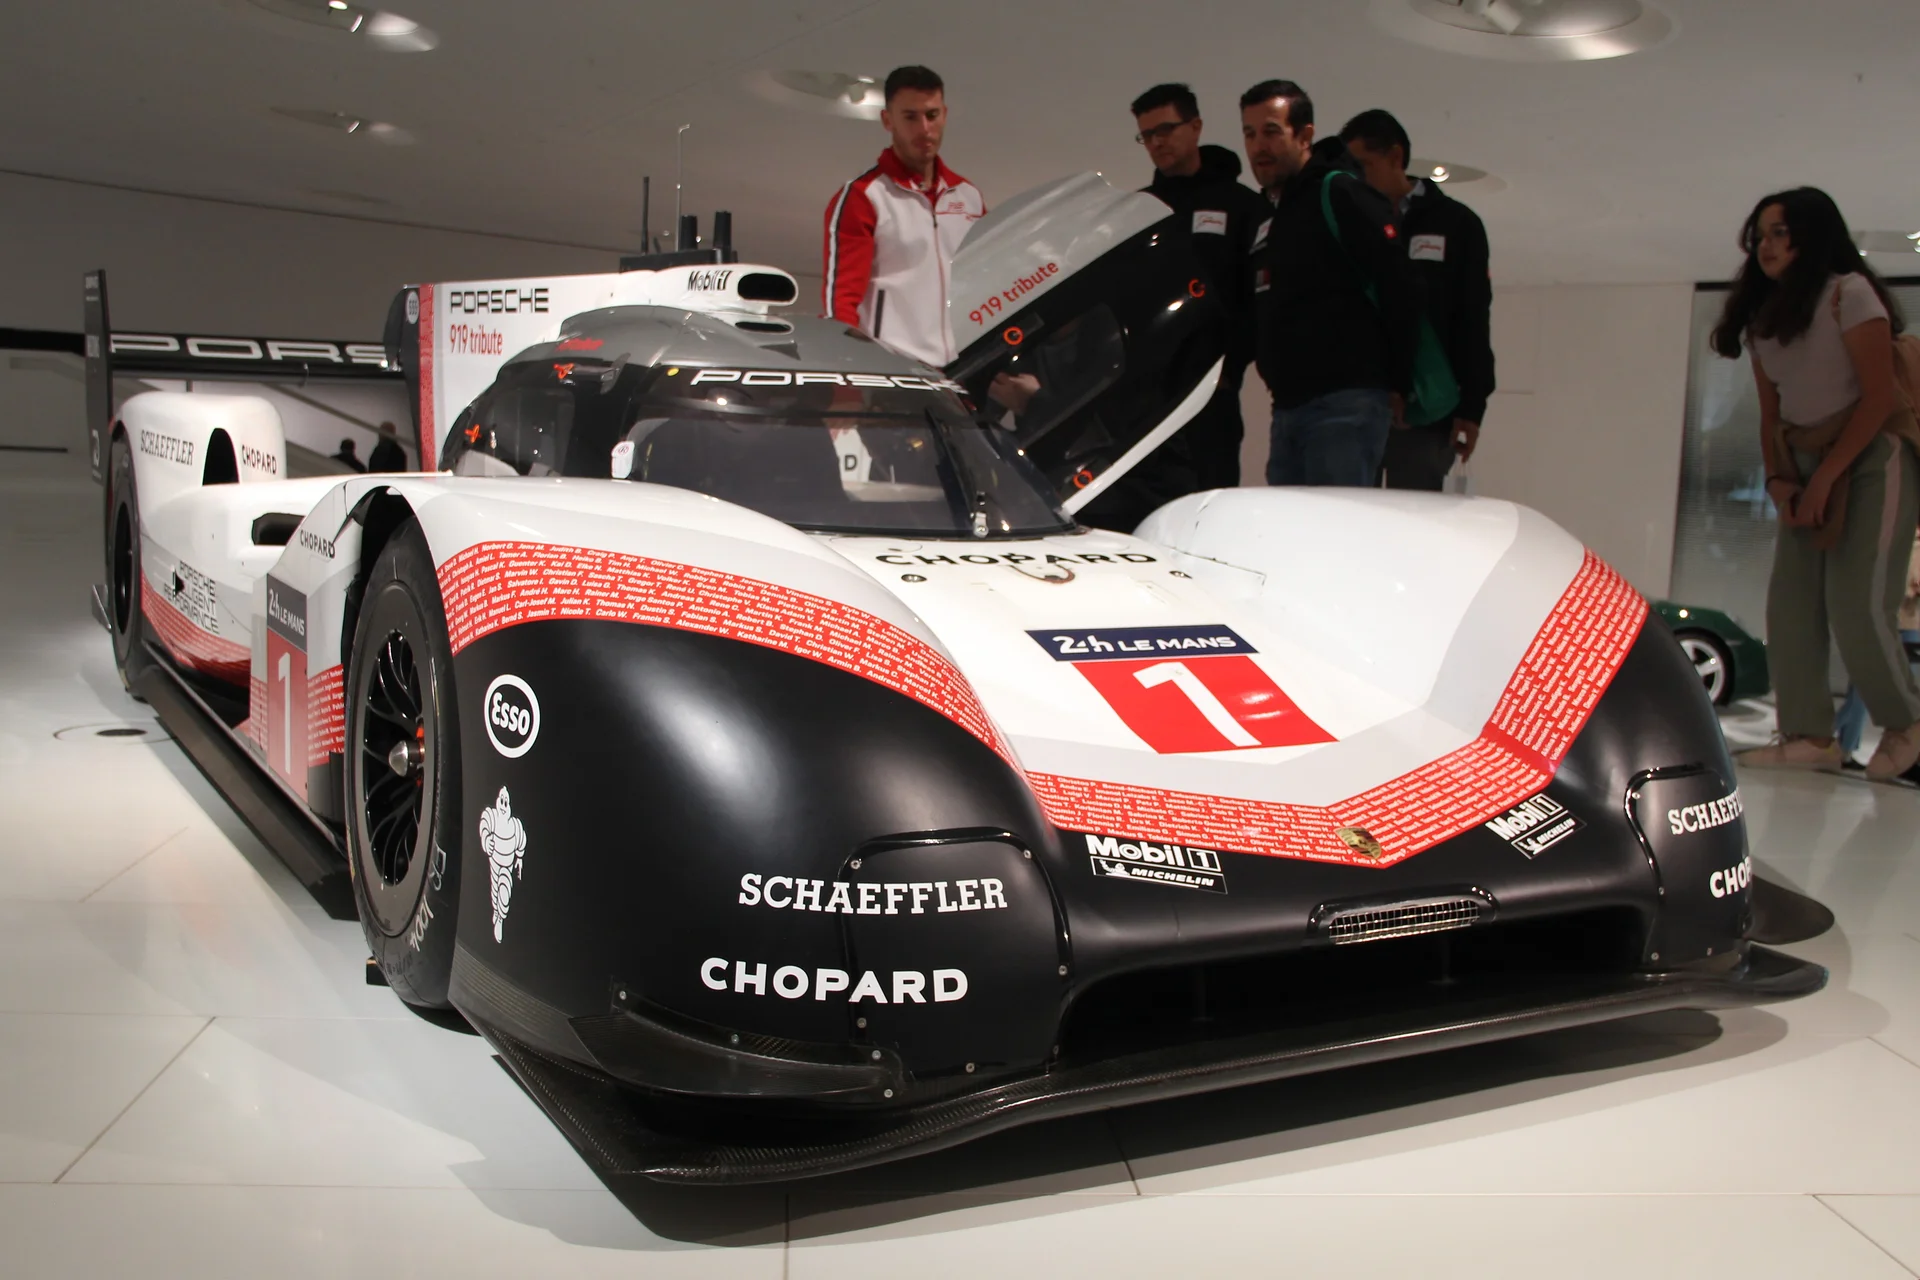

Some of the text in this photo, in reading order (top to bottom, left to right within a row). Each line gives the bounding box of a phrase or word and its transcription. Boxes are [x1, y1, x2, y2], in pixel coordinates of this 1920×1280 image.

[688, 270, 719, 291] Mobil
[969, 262, 1059, 326] 919 tribute
[450, 288, 549, 314] PORSCHE
[110, 333, 386, 364] PORS
[450, 324, 503, 355] 919 tribute
[140, 430, 195, 467] SCHAEFFLER
[241, 444, 277, 475] CHOPARD
[300, 529, 336, 560] CHOPARD
[876, 552, 1157, 566] CHOPARD
[180, 560, 216, 597] PORSCHE
[279, 606, 288, 626] LE
[287, 612, 305, 637] MANS
[1117, 639, 1155, 652] LE
[1156, 636, 1237, 650] MANS
[502, 614, 517, 624] Bernd
[527, 609, 549, 618] Jasmin
[596, 609, 616, 617] Carlo
[633, 613, 662, 622] Francis
[676, 619, 718, 632] Alexander
[737, 631, 777, 645] Katharine
[794, 645, 811, 655] Igor
[828, 656, 852, 669] Armin
[866, 670, 901, 689] Andreas
[915, 691, 943, 711] Torsten
[959, 717, 983, 739] Philipp
[278, 651, 291, 775] 1
[491, 692, 531, 737] Esso
[1133, 661, 1262, 747] 1
[1485, 801, 1548, 841] Mobil
[1667, 786, 1744, 835] SCHAEFFL
[1536, 818, 1576, 845] MICHELIN
[1085, 834, 1185, 867] Mobil
[738, 873, 1008, 916] SCHAEFFLER
[1131, 868, 1215, 887] MICHELIN
[1709, 856, 1753, 899] CHOP
[700, 957, 968, 1005] CHOPARD
